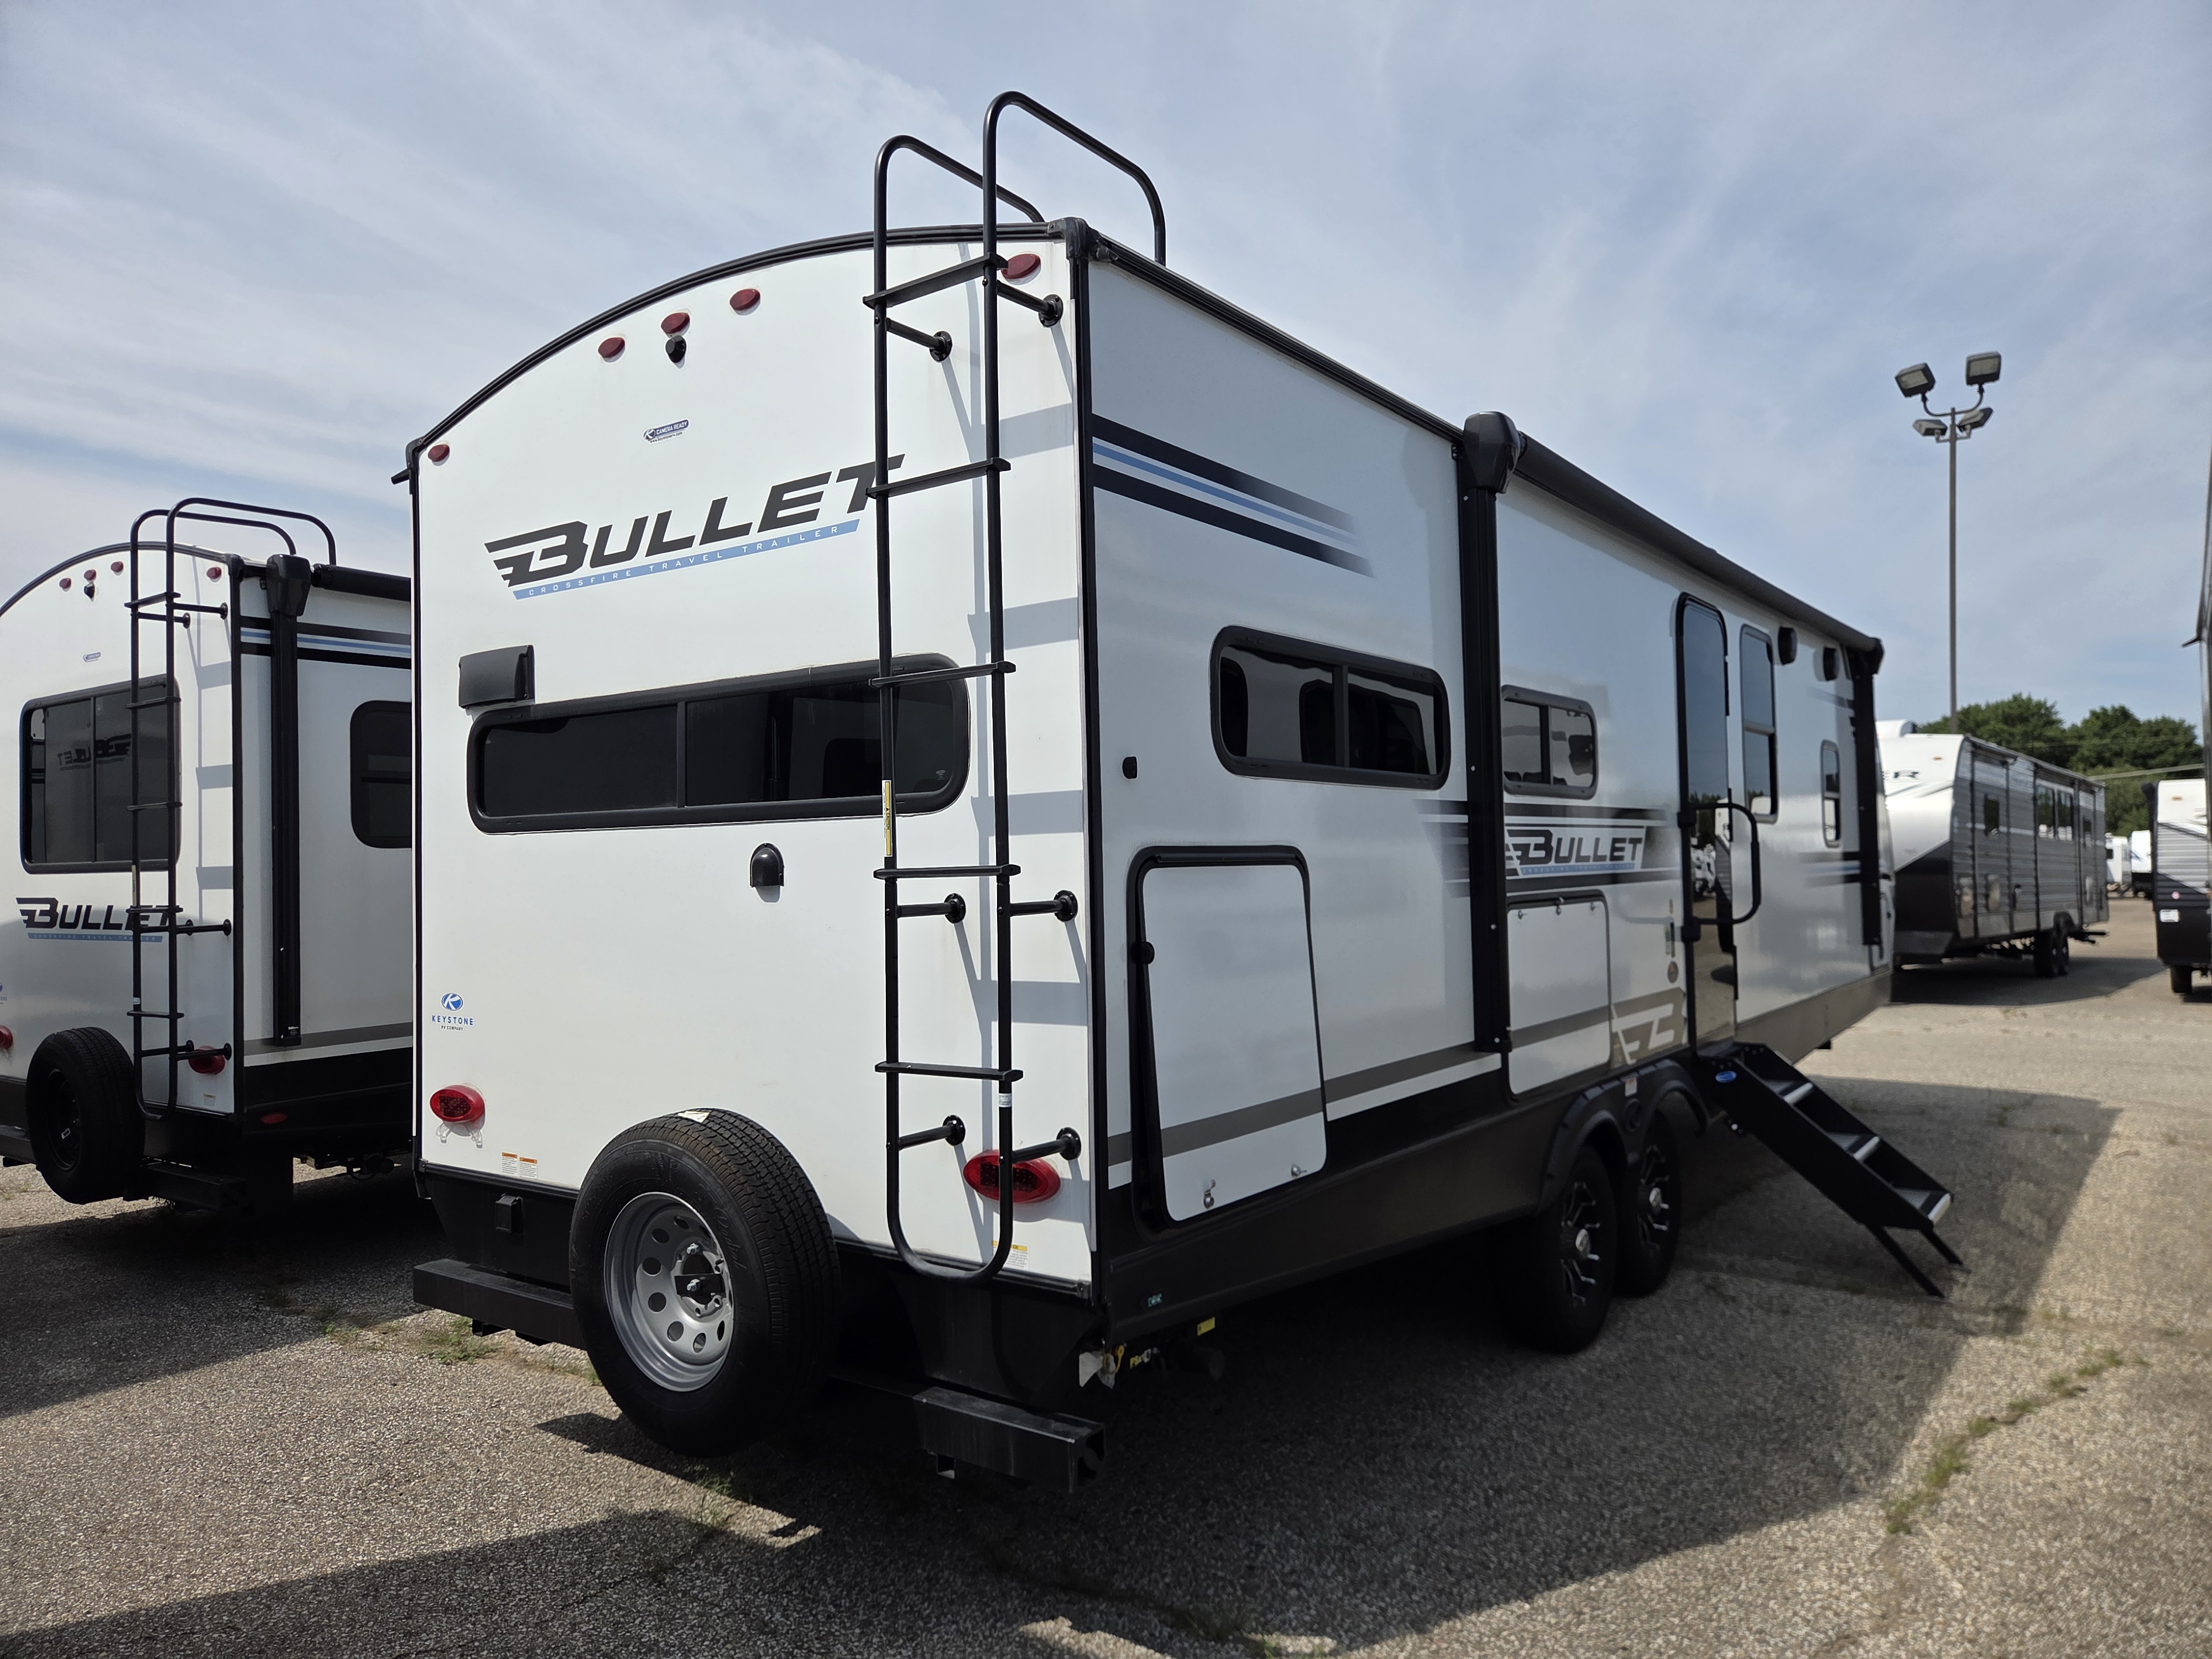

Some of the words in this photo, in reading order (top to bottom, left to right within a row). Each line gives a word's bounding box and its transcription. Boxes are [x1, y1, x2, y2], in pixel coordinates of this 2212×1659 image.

[656, 426, 673, 435] CAMERA
[484, 453, 905, 587] BULLET
[529, 570, 632, 596] CROSSFIRE
[649, 552, 723, 572] TRAVEL
[742, 526, 838, 553] TRAILER
[1507, 830, 1642, 865] BULLET
[431, 1014, 473, 1026] KEYSTONE
